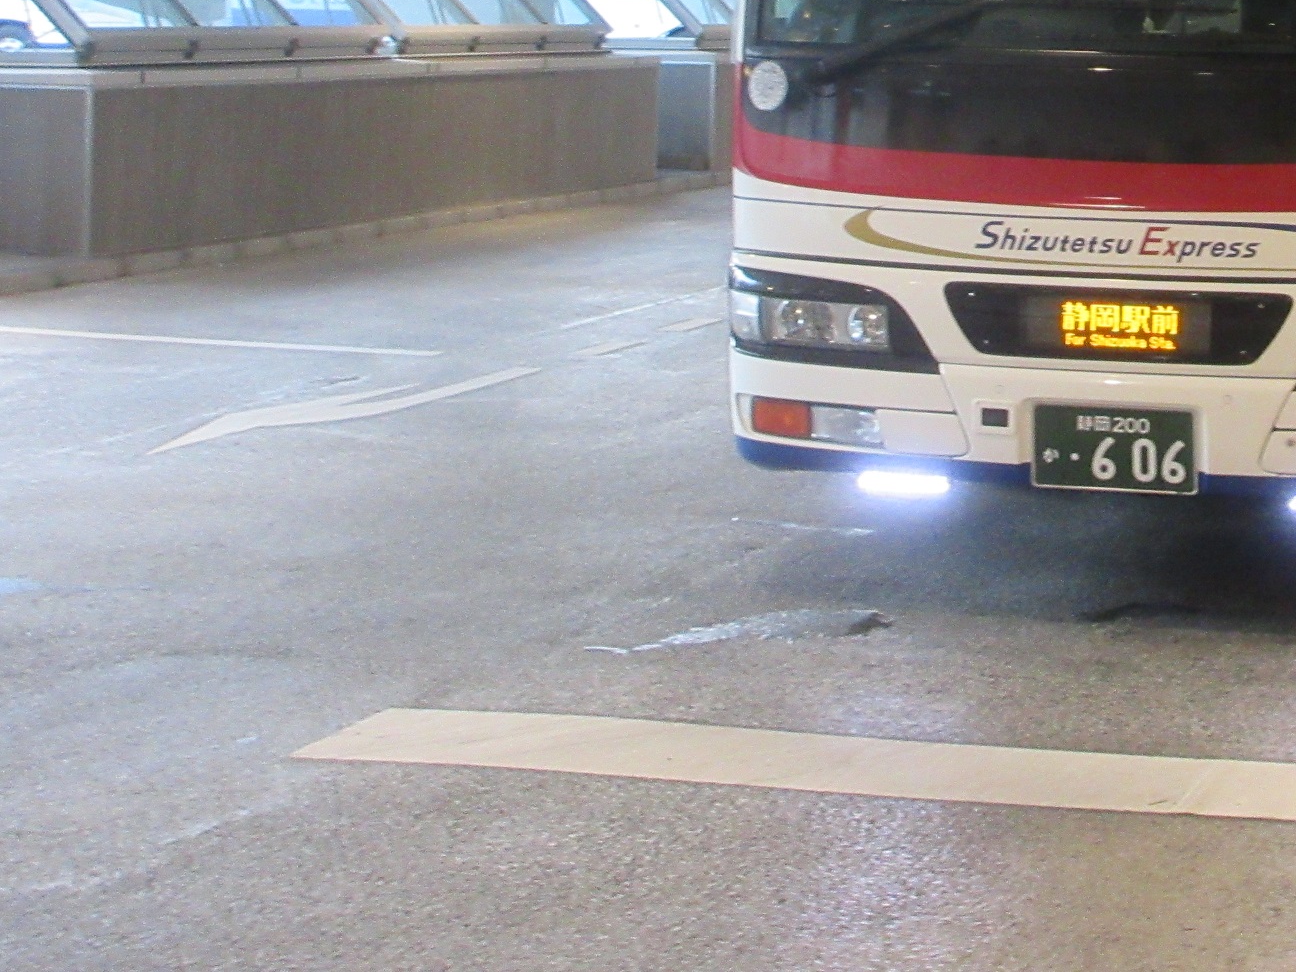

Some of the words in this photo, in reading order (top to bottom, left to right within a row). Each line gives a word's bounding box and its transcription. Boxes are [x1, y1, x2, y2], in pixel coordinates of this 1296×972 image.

[975, 220, 1133, 254] Shizutetsu
[1139, 226, 1260, 263] Express
[1061, 301, 1179, 335] 静岡駅前
